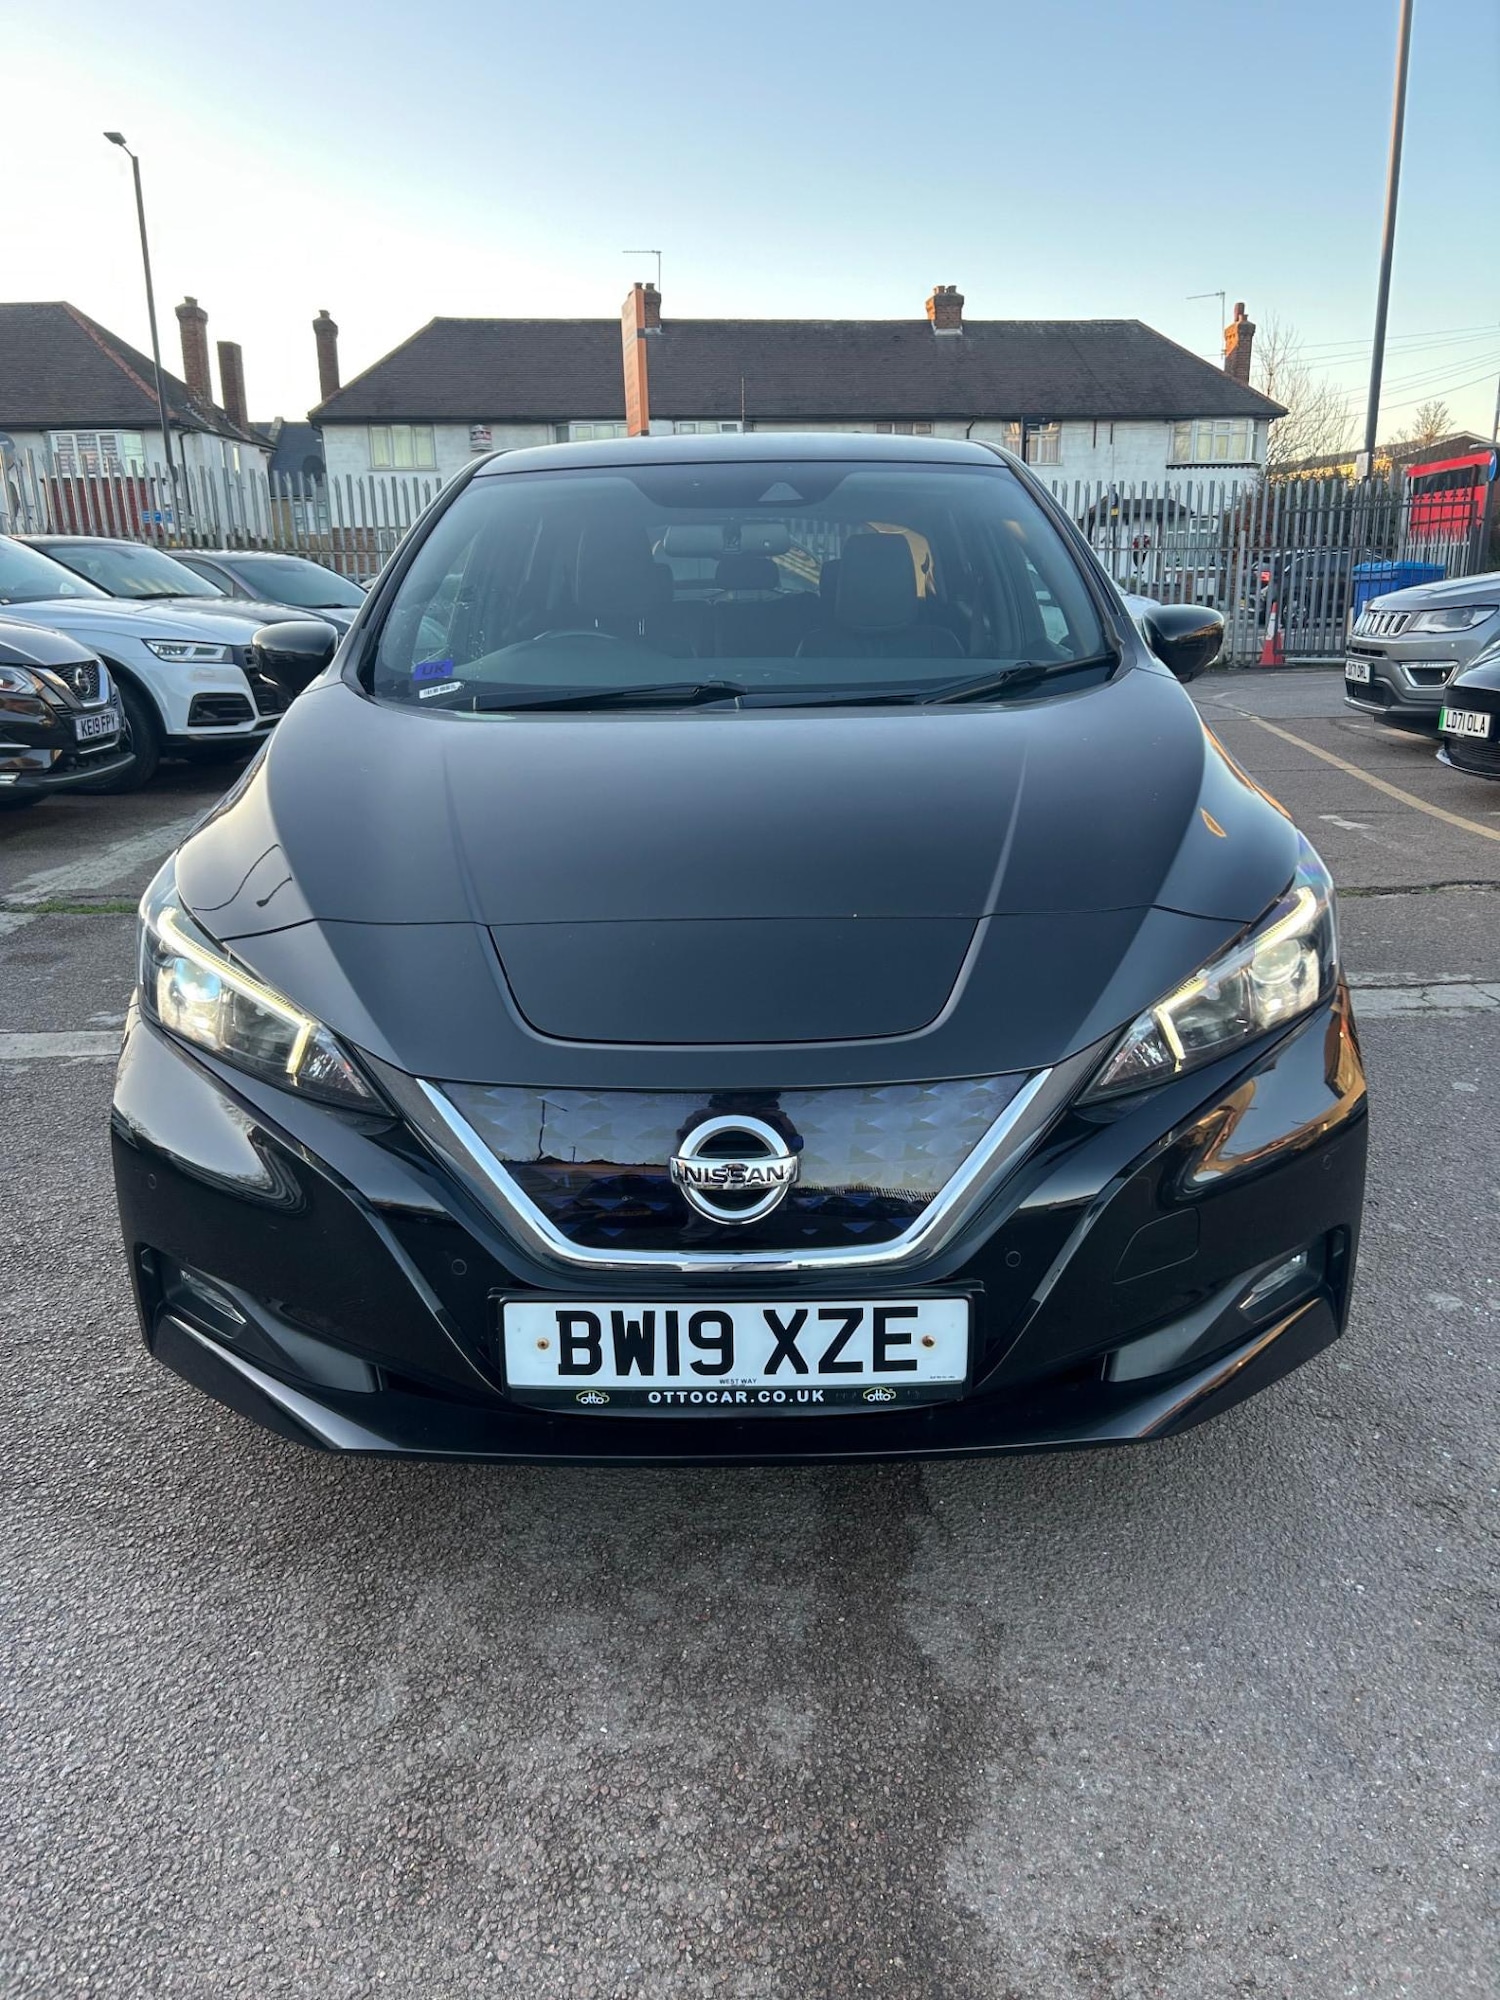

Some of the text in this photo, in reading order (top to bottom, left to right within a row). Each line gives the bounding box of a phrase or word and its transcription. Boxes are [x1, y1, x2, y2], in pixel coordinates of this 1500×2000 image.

[422, 663, 446, 675] UK
[80, 712, 115, 738] KE19 FPY
[1446, 710, 1486, 734] LD71 OLA
[684, 1165, 784, 1184] NISSAN
[555, 1306, 919, 1377] BW19 XZE
[580, 1392, 605, 1405] otto
[648, 1389, 825, 1404] OTTOCAR.CO.UK
[867, 1389, 892, 1402] otto
